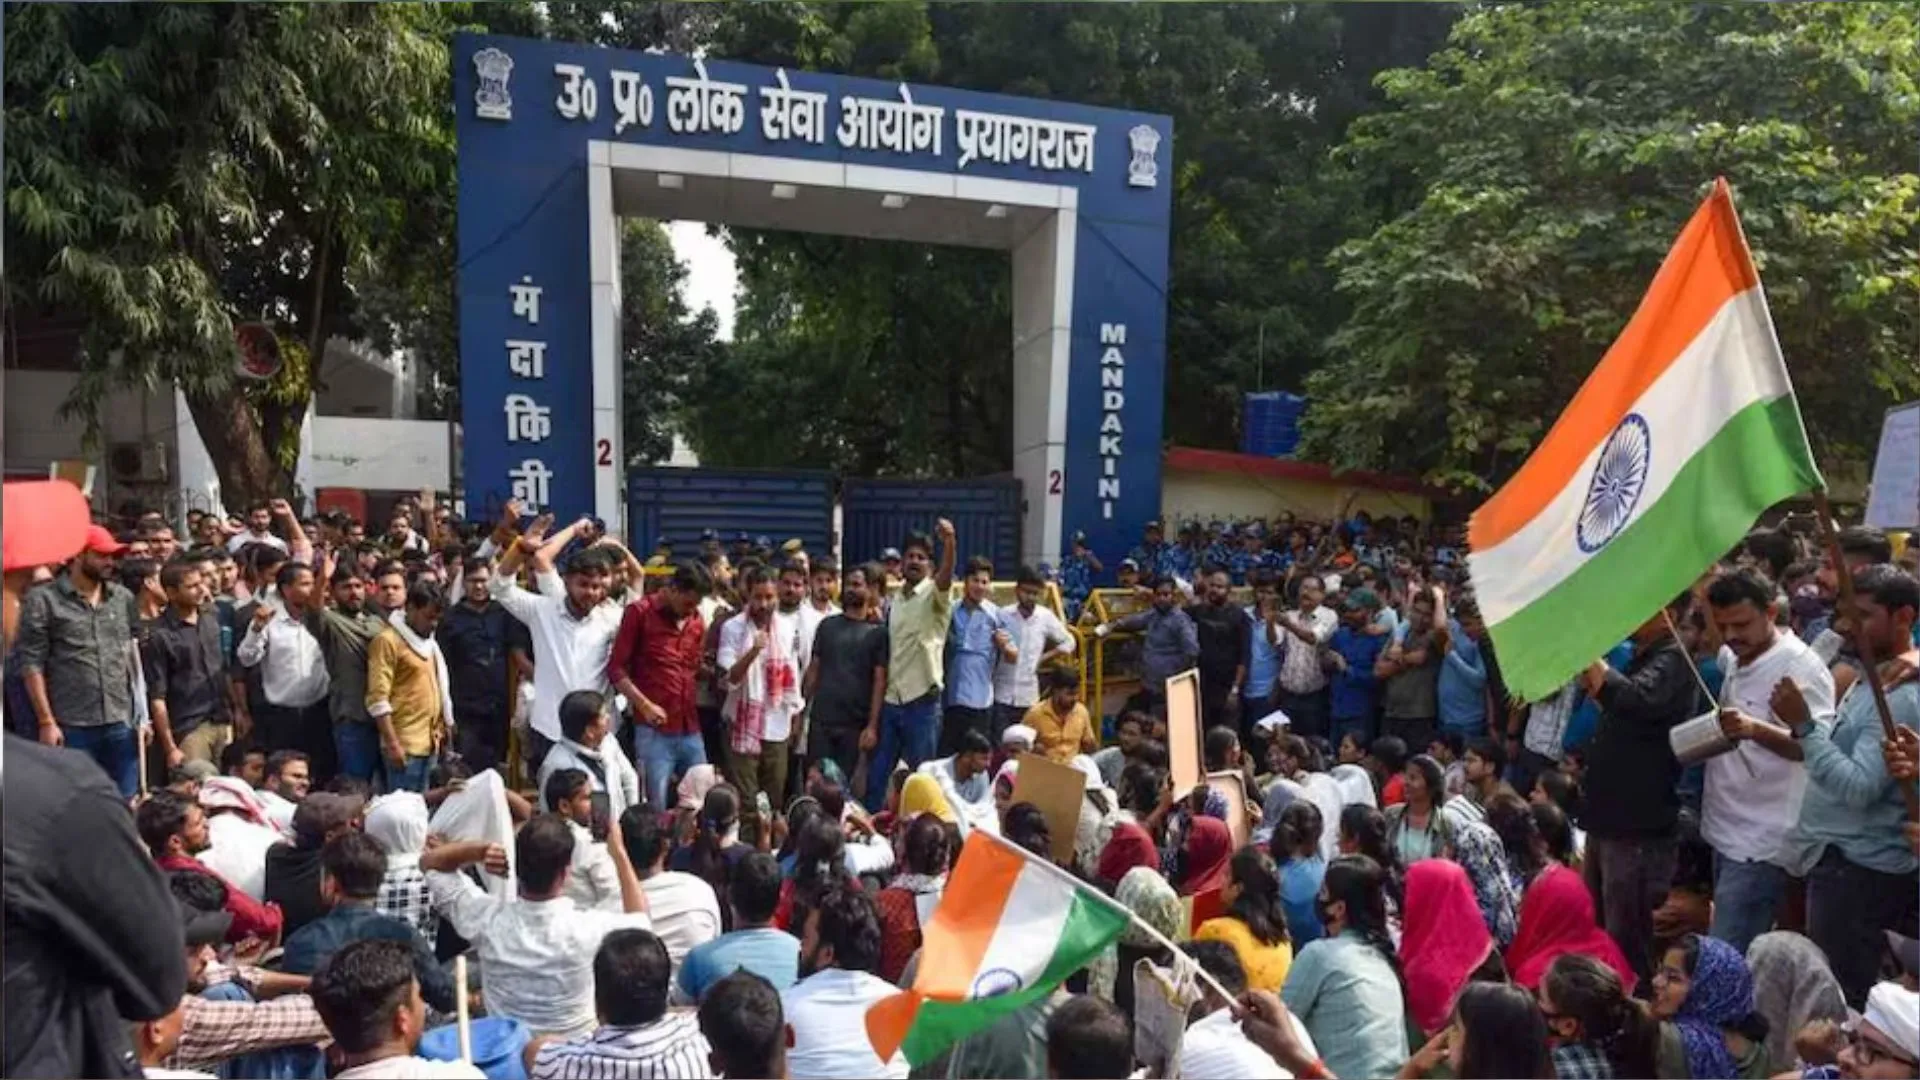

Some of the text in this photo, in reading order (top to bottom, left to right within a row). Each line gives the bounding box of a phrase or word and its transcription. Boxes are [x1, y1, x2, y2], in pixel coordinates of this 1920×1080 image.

[665, 57, 748, 134] लोक
[759, 66, 828, 144] सेवा
[836, 82, 945, 156] आयोग
[955, 109, 1097, 173] प्रयागराज
[597, 439, 612, 466] 2
[1098, 322, 1126, 519] MANDAKINI
[1049, 470, 1062, 494] 2
